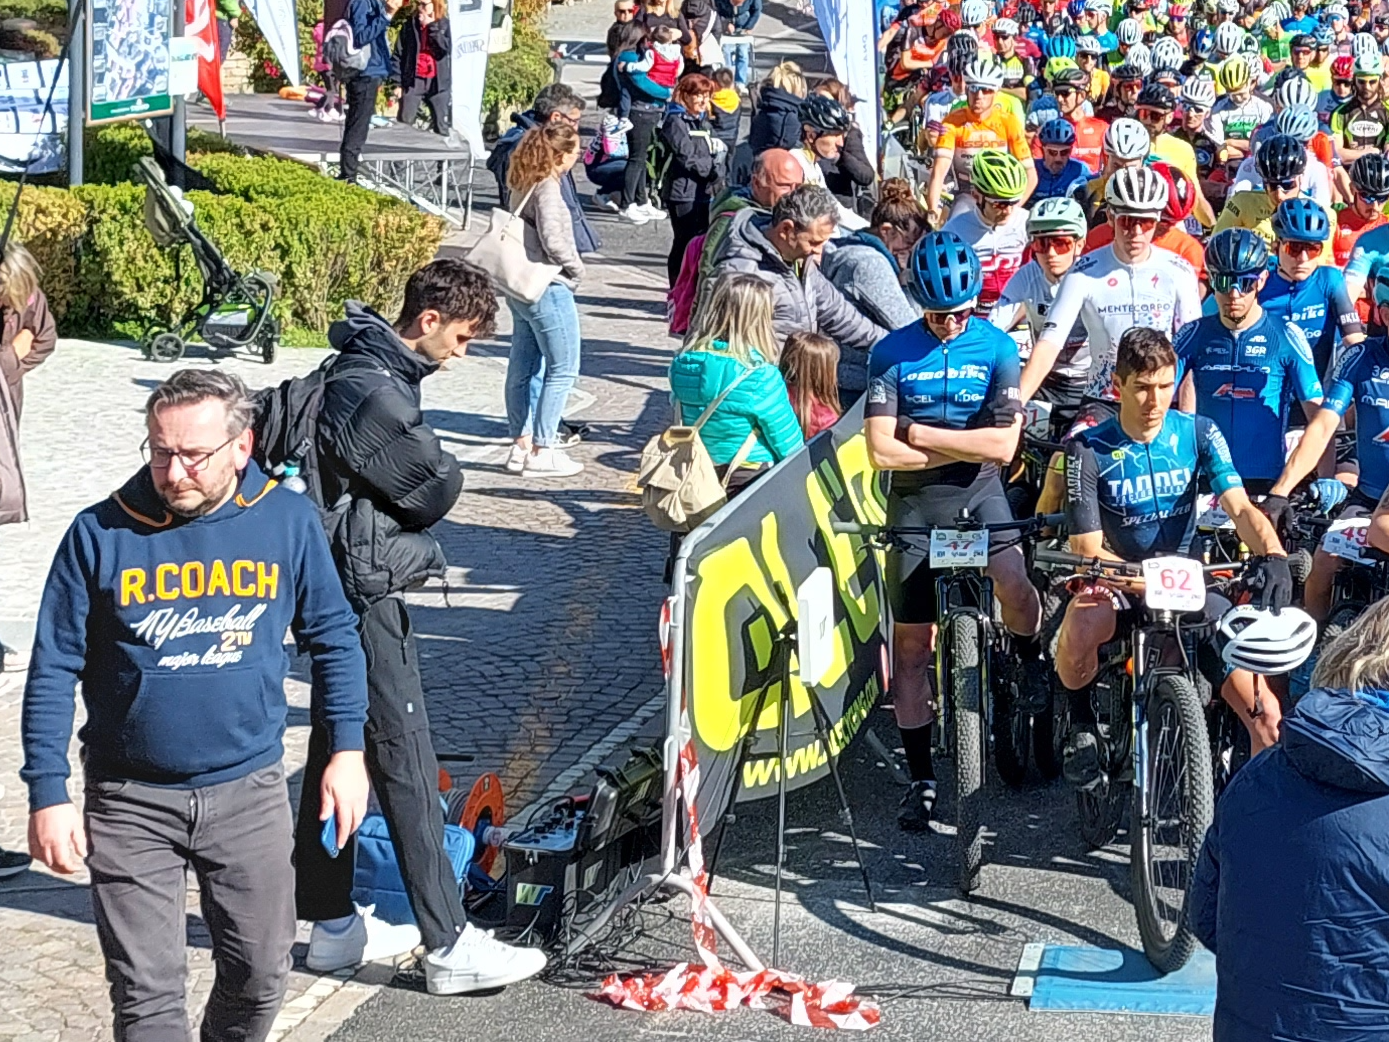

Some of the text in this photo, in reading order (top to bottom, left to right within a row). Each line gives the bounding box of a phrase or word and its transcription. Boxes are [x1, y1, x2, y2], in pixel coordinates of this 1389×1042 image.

[1097, 303, 1171, 314] MENTECORPO
[1121, 503, 1192, 528] SPECIALIZED
[943, 540, 975, 550] 47
[120, 559, 280, 607] R.COACH
[1160, 569, 1192, 591] 62
[172, 603, 268, 640] Baseball
[157, 645, 243, 670] major league
